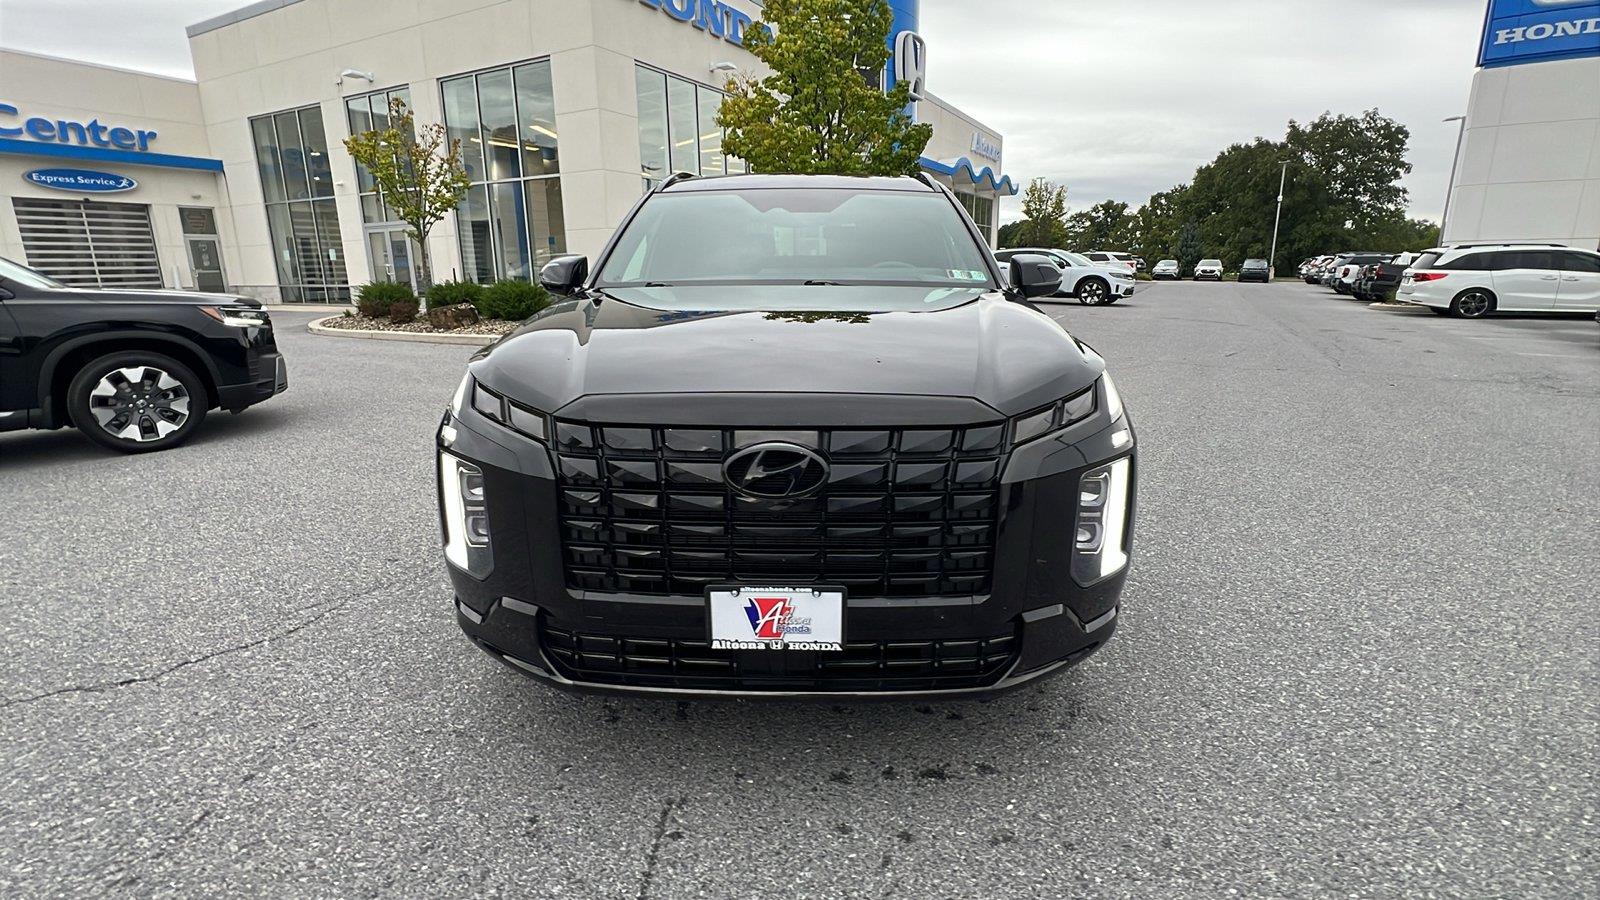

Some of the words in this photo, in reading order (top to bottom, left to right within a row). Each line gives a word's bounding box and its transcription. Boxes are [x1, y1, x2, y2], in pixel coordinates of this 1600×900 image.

[638, 0, 775, 49] OND
[0, 103, 157, 151] Center
[32, 173, 75, 184] Express
[77, 176, 115, 186] Service
[711, 640, 766, 650] Altoona
[788, 642, 842, 651] HONDA
